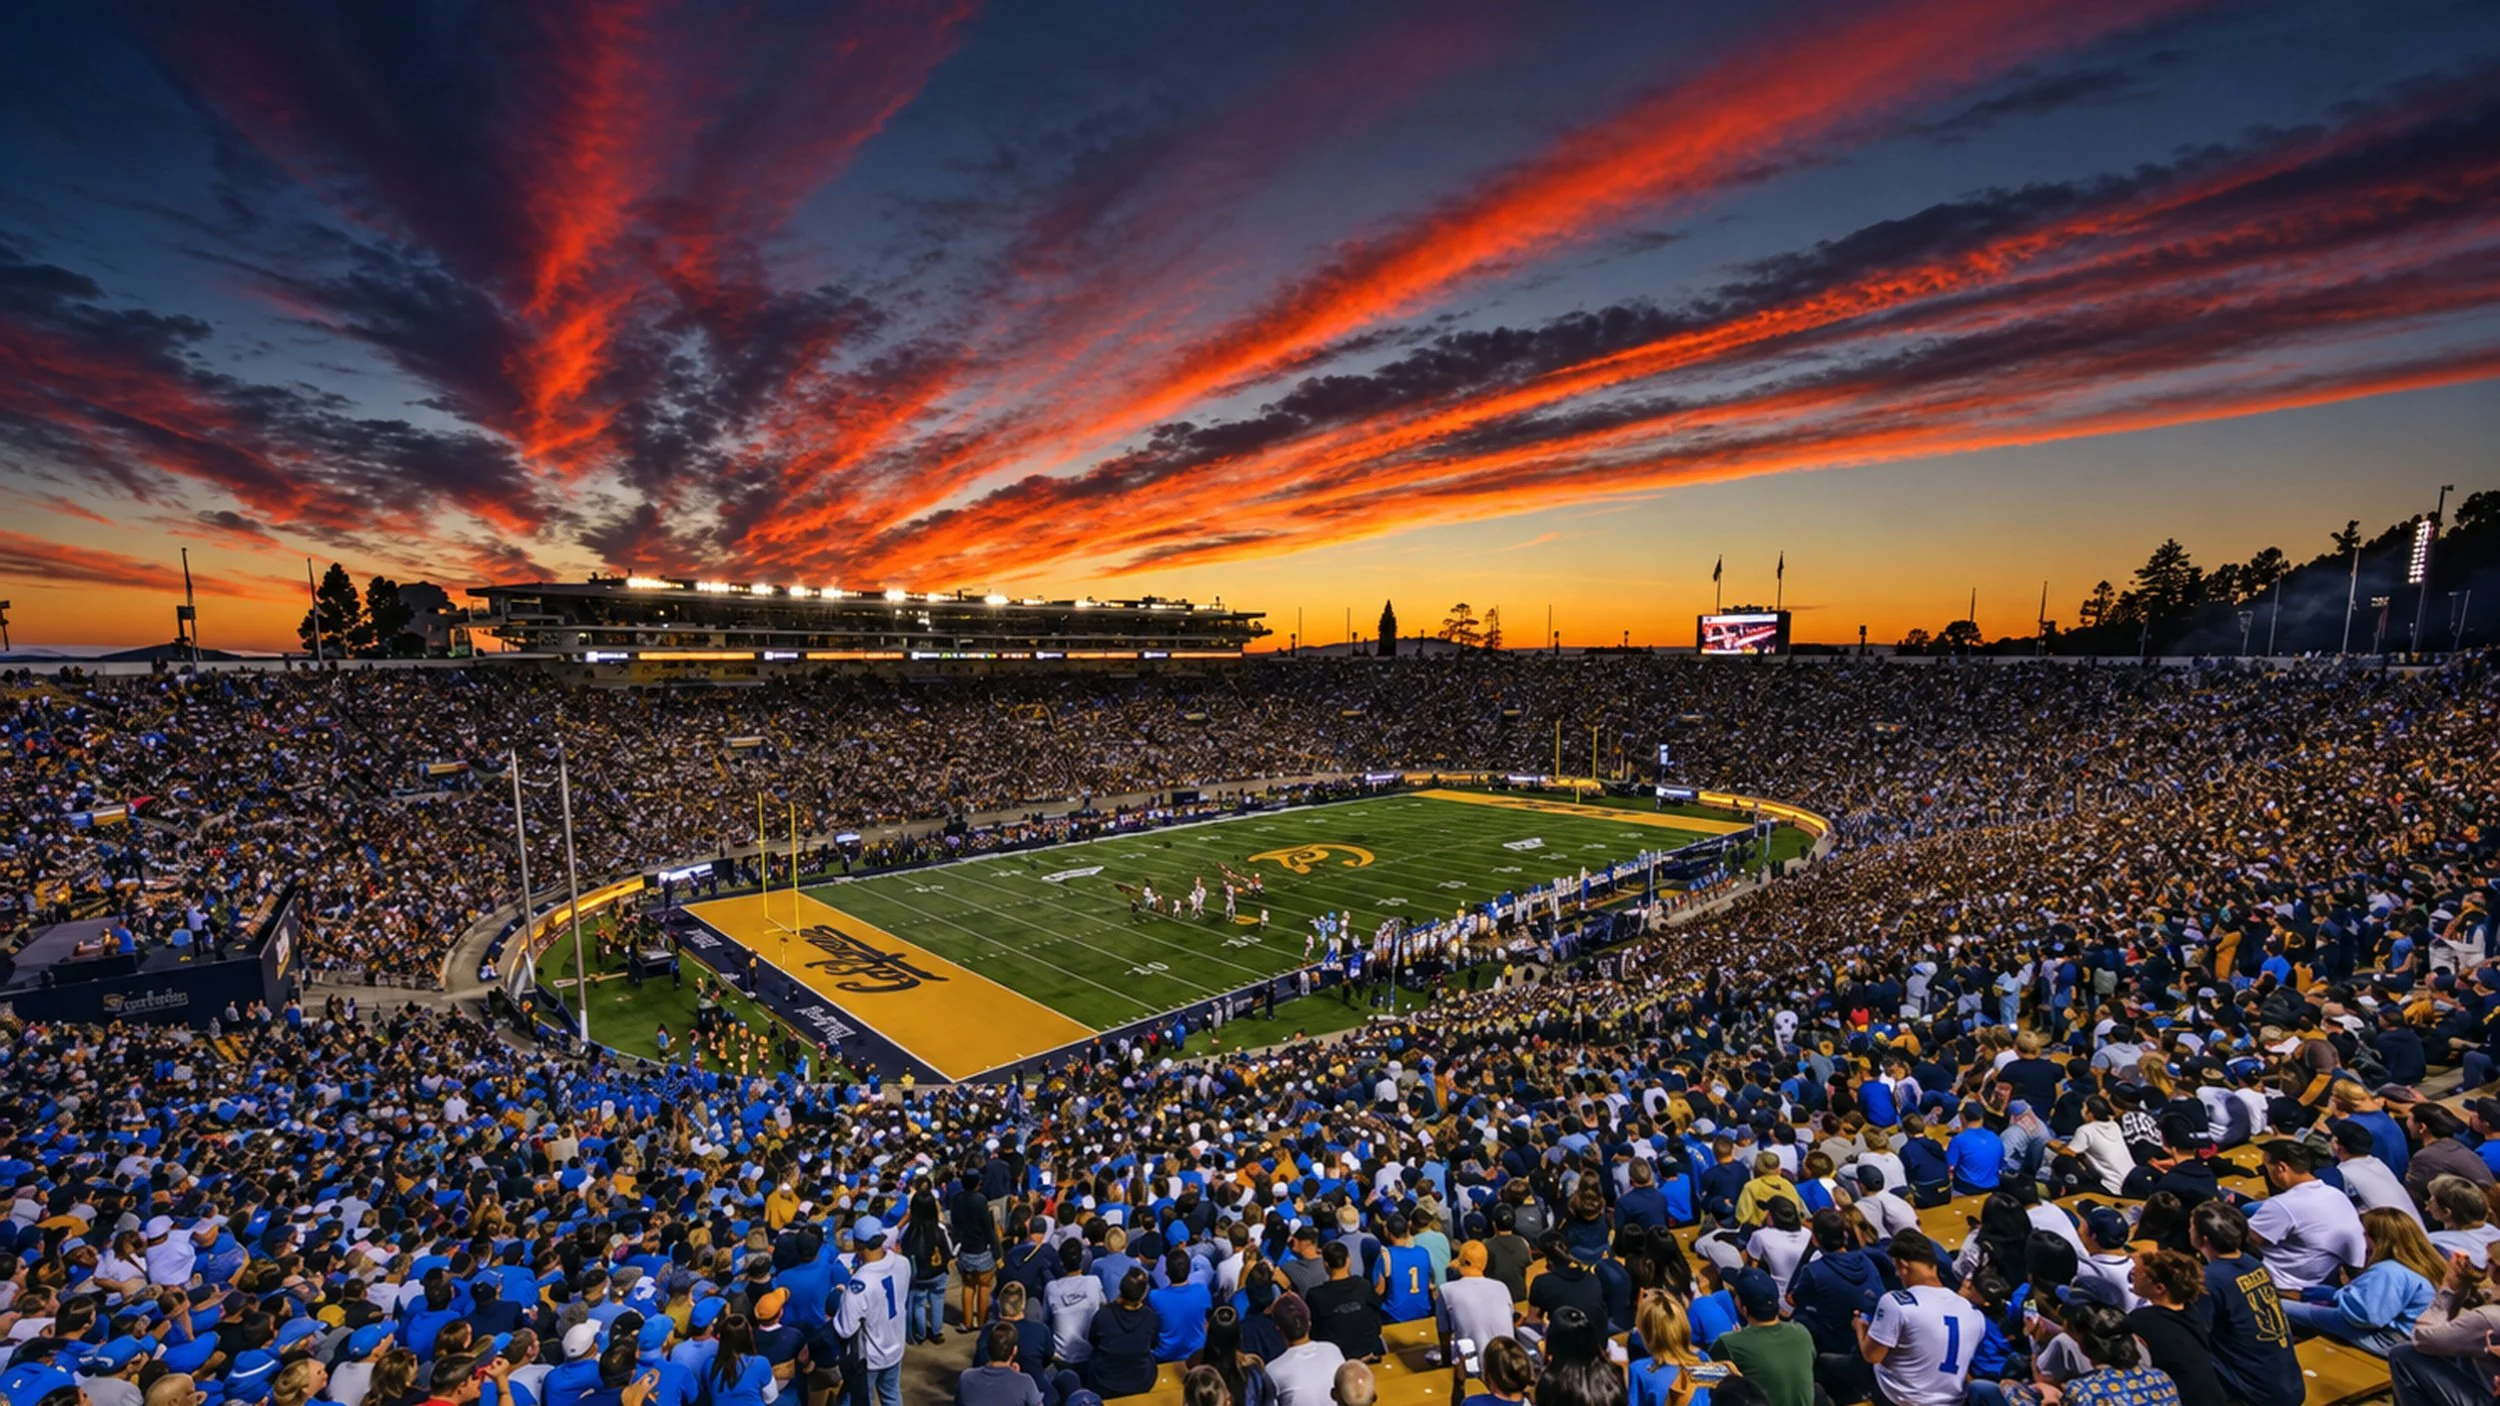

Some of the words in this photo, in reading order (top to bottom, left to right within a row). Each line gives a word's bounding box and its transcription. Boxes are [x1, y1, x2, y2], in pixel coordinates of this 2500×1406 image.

[881, 1275, 897, 1320] 1
[1408, 1266, 1420, 1294] 1
[1938, 1315, 1960, 1375] 1
